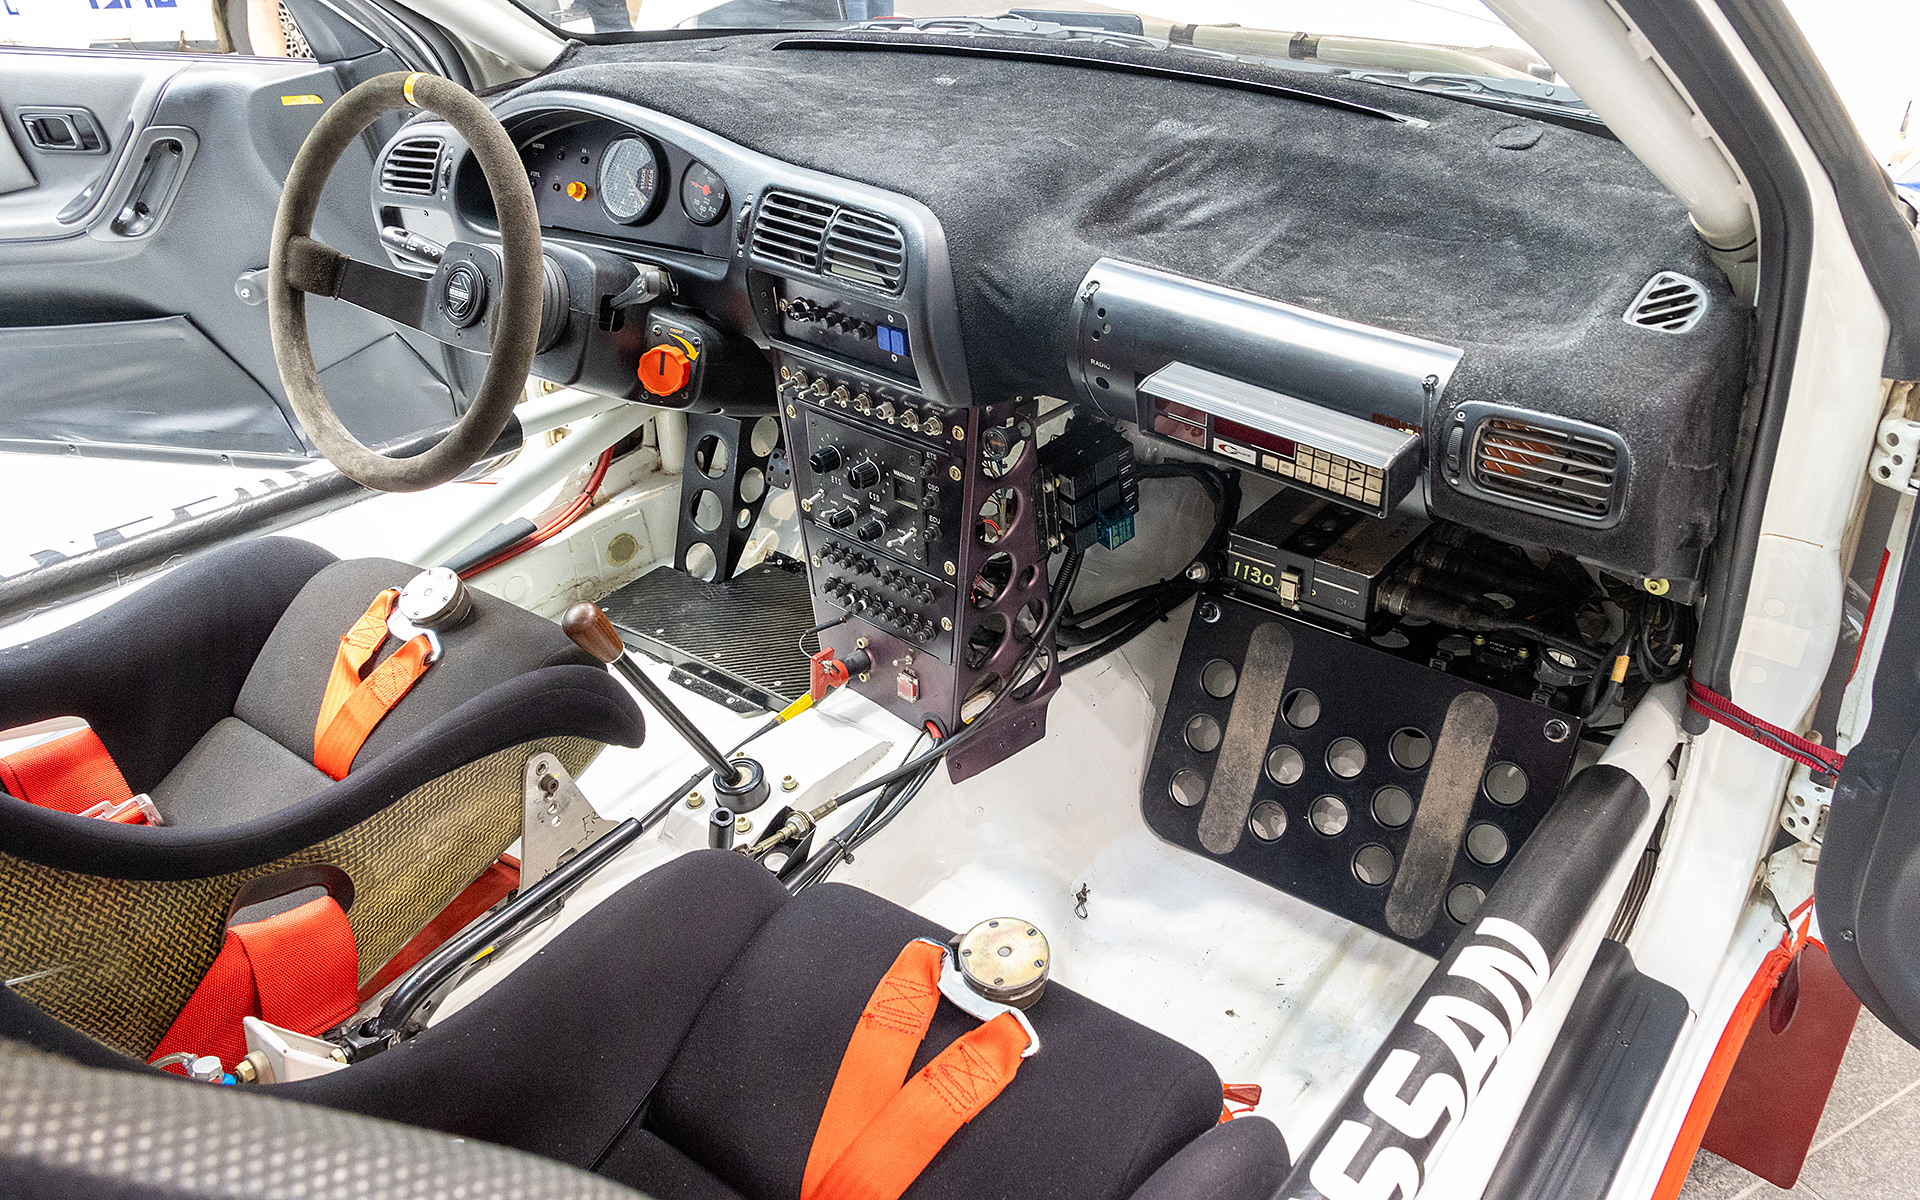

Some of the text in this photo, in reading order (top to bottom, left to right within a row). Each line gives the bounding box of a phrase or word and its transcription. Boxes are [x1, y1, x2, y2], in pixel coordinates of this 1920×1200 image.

[1090, 358, 1111, 370] RADIO
[926, 451, 938, 461] ETS
[831, 475, 841, 486] ETS
[892, 468, 916, 483] WARNING
[928, 514, 941, 525] ECU
[1234, 561, 1274, 586] 1130
[1288, 916, 1552, 1200] SSAN
